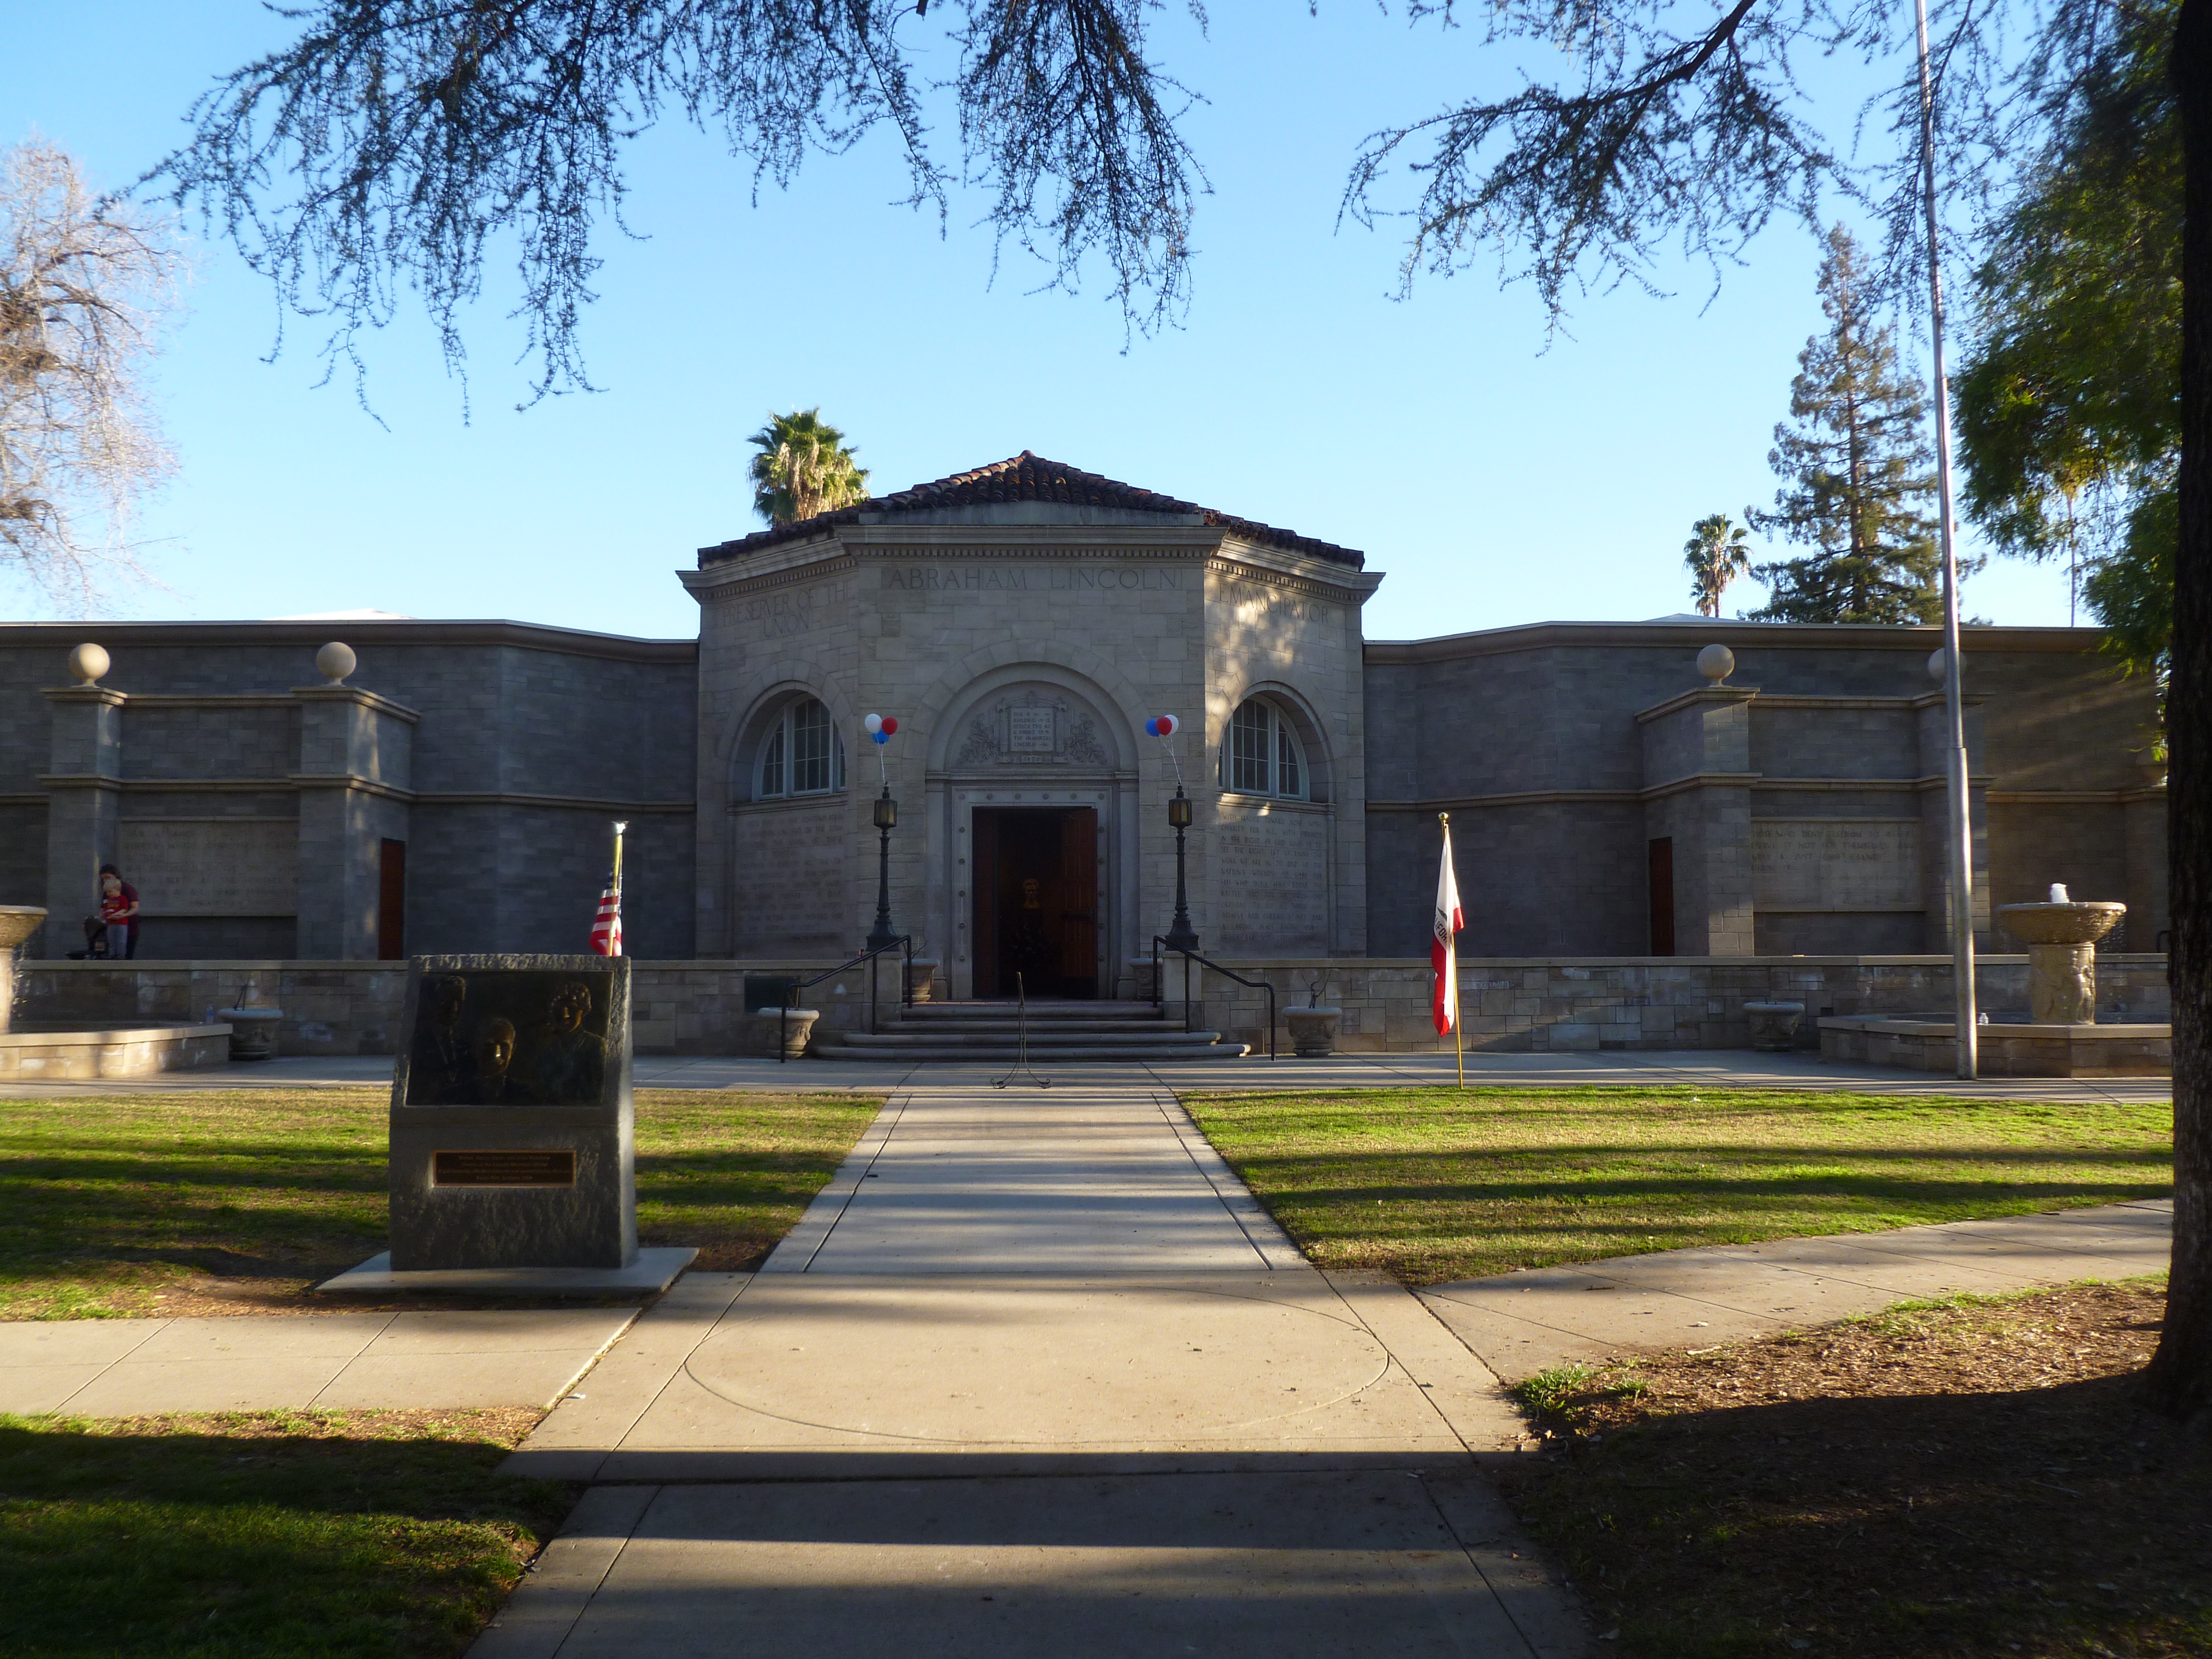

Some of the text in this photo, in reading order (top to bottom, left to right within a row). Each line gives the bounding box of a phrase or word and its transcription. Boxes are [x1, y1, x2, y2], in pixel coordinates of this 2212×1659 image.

[888, 568, 1176, 590] ABRAHAM LINCOLN
[722, 581, 854, 627] PRESERVER OF THE
[1219, 583, 1329, 624] EMANCIPATOR
[763, 612, 809, 637] UNION
